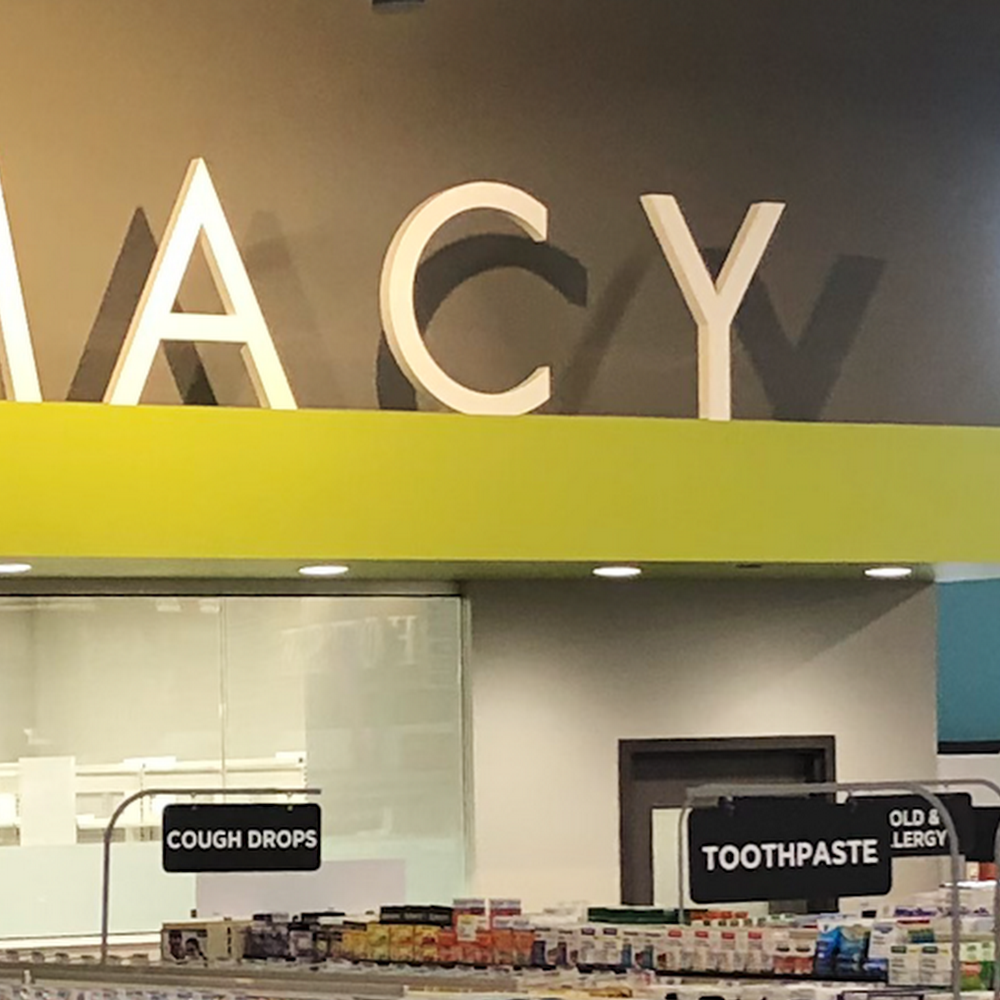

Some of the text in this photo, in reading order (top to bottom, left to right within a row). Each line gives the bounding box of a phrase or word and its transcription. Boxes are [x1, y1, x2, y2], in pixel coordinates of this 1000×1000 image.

[888, 809, 926, 828] OLD
[166, 827, 319, 852] COUGH DROPS
[702, 839, 880, 872] TOOTHPASTE
